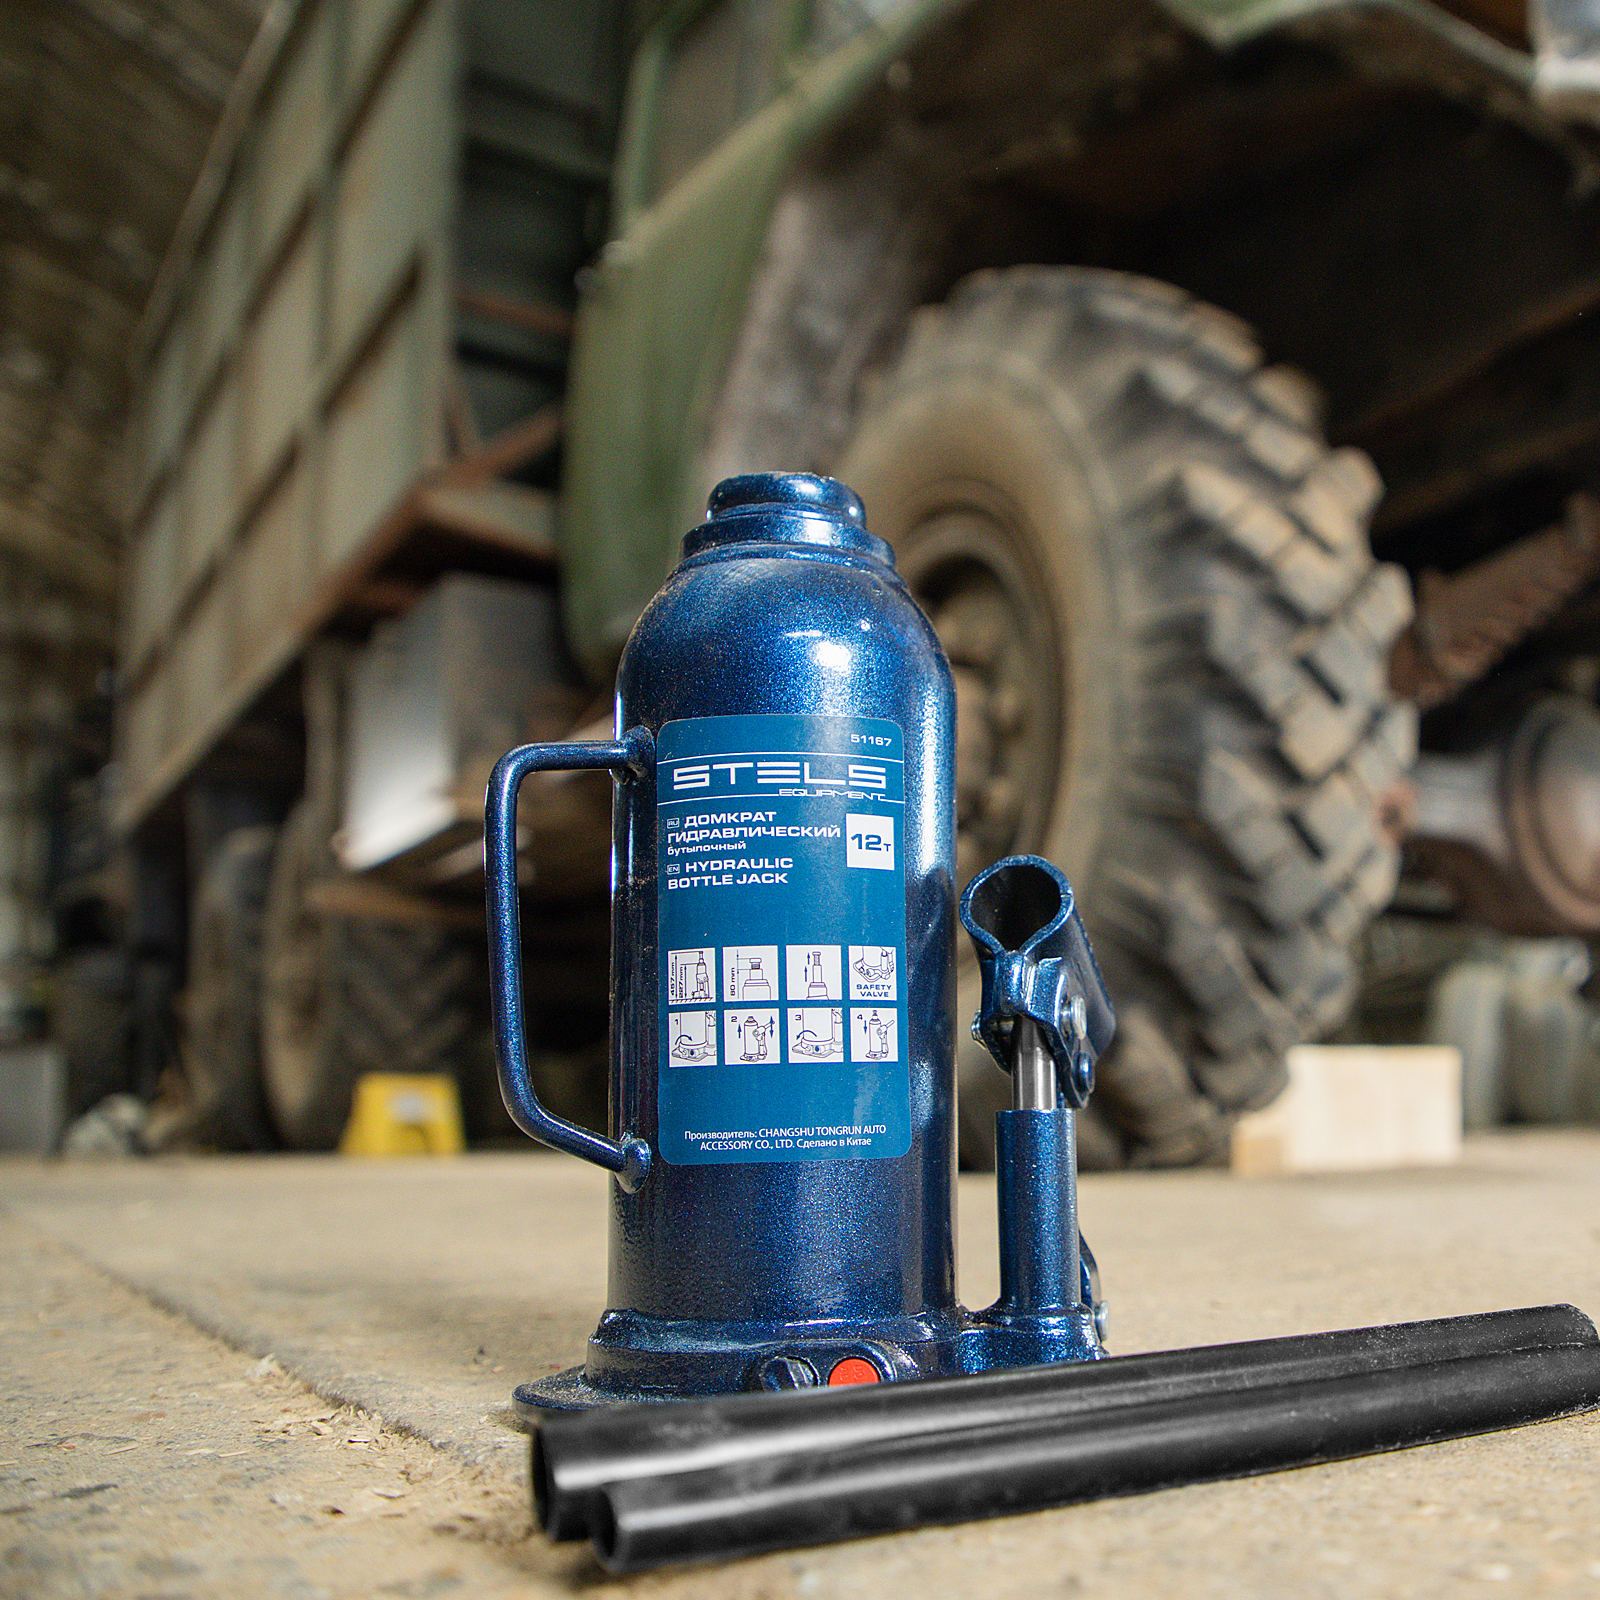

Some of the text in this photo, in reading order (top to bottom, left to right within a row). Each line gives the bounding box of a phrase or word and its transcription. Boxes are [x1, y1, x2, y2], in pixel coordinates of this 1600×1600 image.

[850, 733, 892, 747] 51167
[673, 761, 886, 791] STELS
[778, 788, 886, 801] EQUIPMENT
[684, 811, 777, 829] ДОМКРАТ
[667, 825, 841, 844] ГИДРАВЛИЧЕСКИЙ
[667, 840, 747, 857] бутылочный
[685, 858, 794, 873] HYDRAULIC
[668, 873, 789, 890] BOTTLE JACK
[729, 967, 736, 997] 80 mm
[856, 983, 892, 991] SAFETY
[674, 1018, 680, 1026] 1
[730, 1015, 738, 1023] 2
[856, 1013, 863, 1021] 4
[684, 1124, 887, 1142] Производитель: CHANGSHU TONGRUN AUTO
[700, 1140, 753, 1151] ACCESSORY
[754, 1139, 773, 1150] CO.,
[775, 1138, 795, 1149] LTD.
[796, 1138, 838, 1149] Сделано
[846, 1137, 872, 1146] Китае
